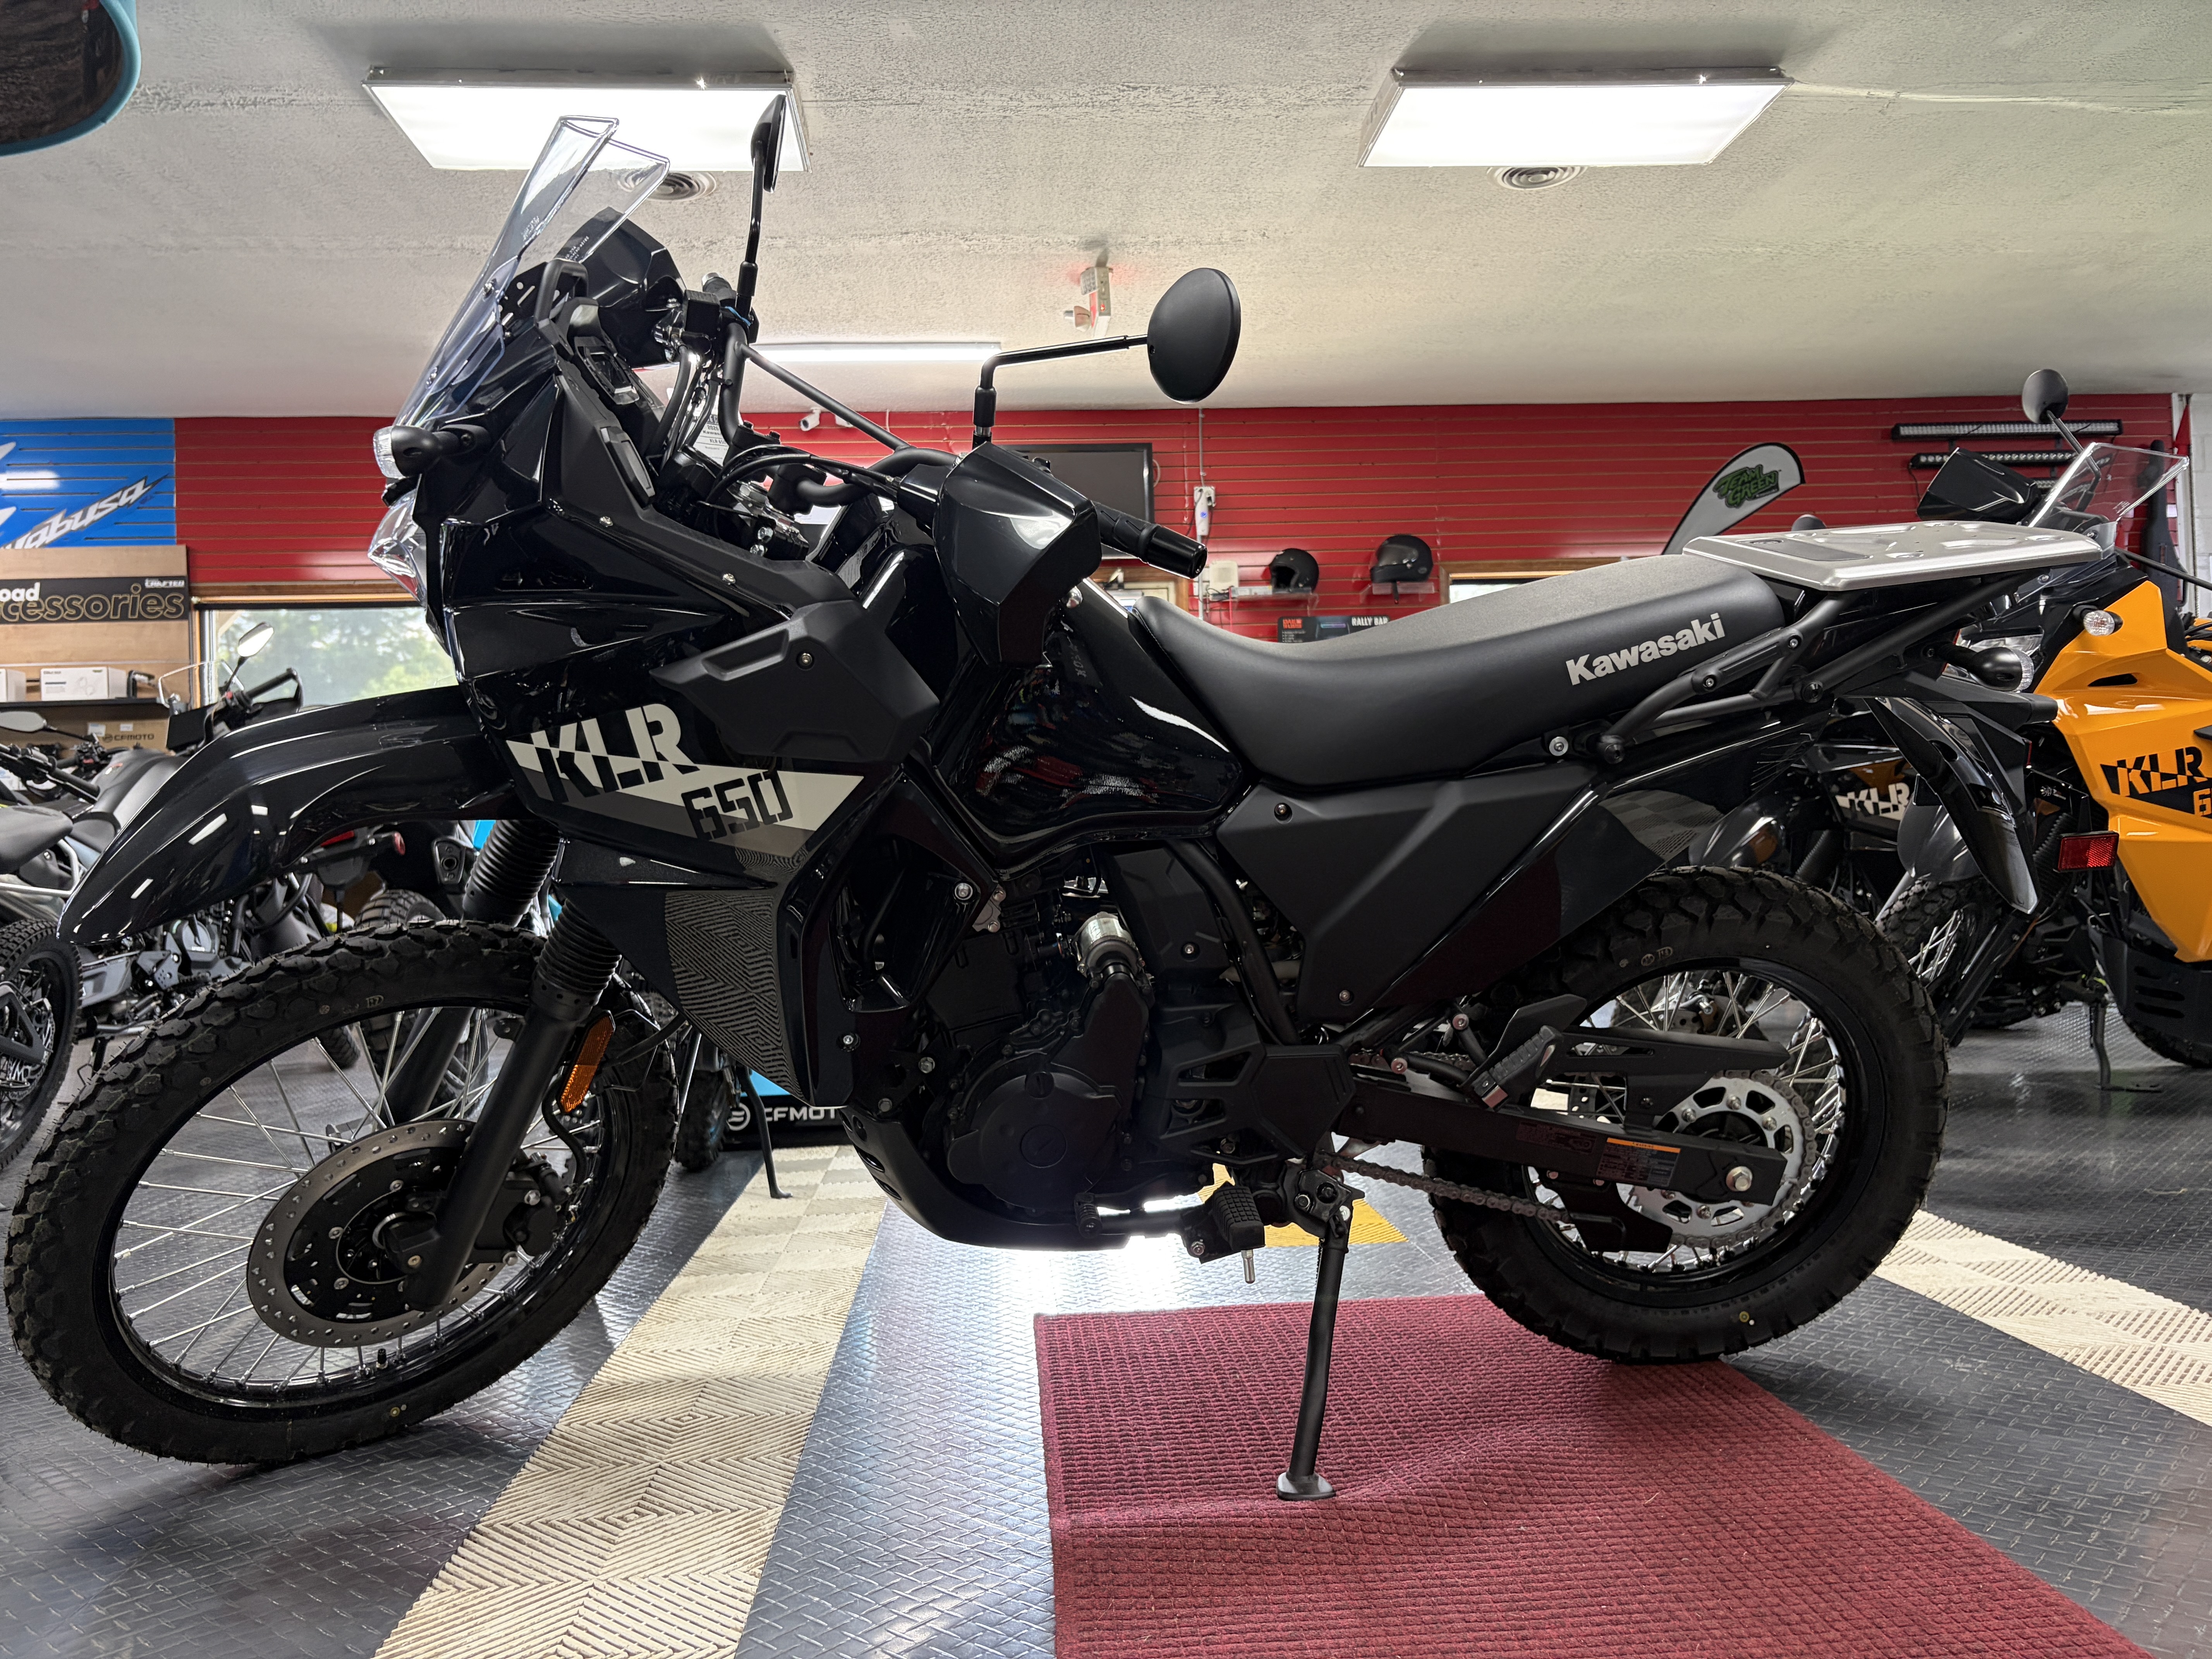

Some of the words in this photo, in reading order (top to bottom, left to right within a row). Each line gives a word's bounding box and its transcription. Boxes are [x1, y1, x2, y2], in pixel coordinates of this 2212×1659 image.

[1715, 466, 1760, 496] TEAM
[1727, 472, 1777, 507] GREEN
[1352, 617, 1372, 626] RALLY
[1566, 613, 1725, 685] Kawasaki
[530, 703, 701, 803] KLR
[2117, 746, 2208, 797] KLR
[681, 770, 793, 841] 650
[1847, 782, 1910, 818] KLR
[2193, 788, 2212, 816] 6
